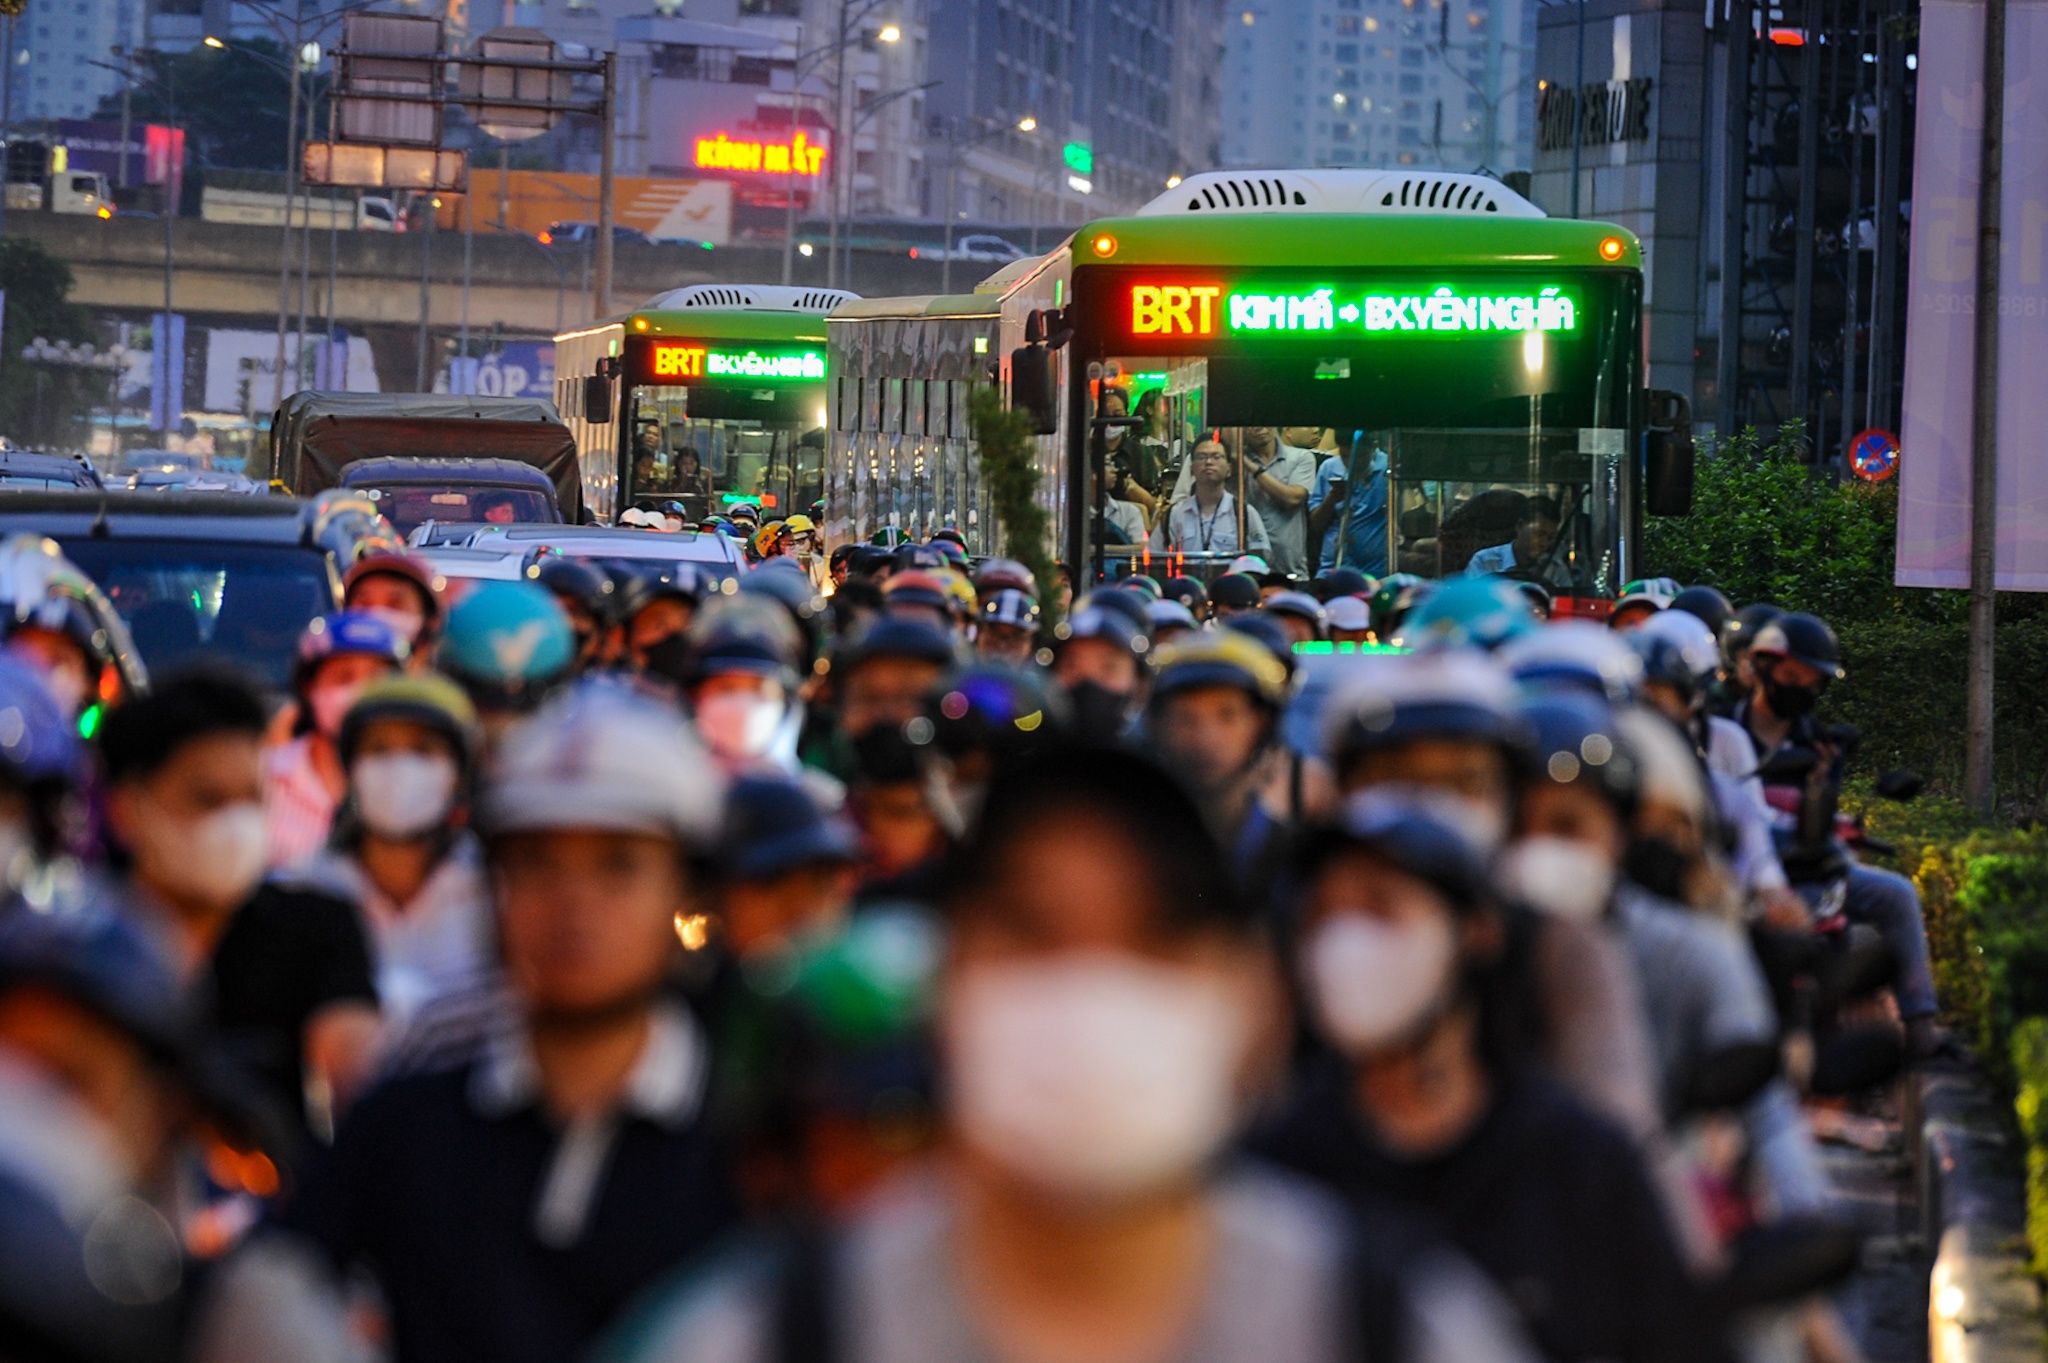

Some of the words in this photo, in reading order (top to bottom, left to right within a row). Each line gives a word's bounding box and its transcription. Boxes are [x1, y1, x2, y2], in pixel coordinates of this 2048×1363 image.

[1132, 286, 1219, 334] BRT
[1230, 294, 1285, 330] KIM
[655, 347, 704, 375] BRT
